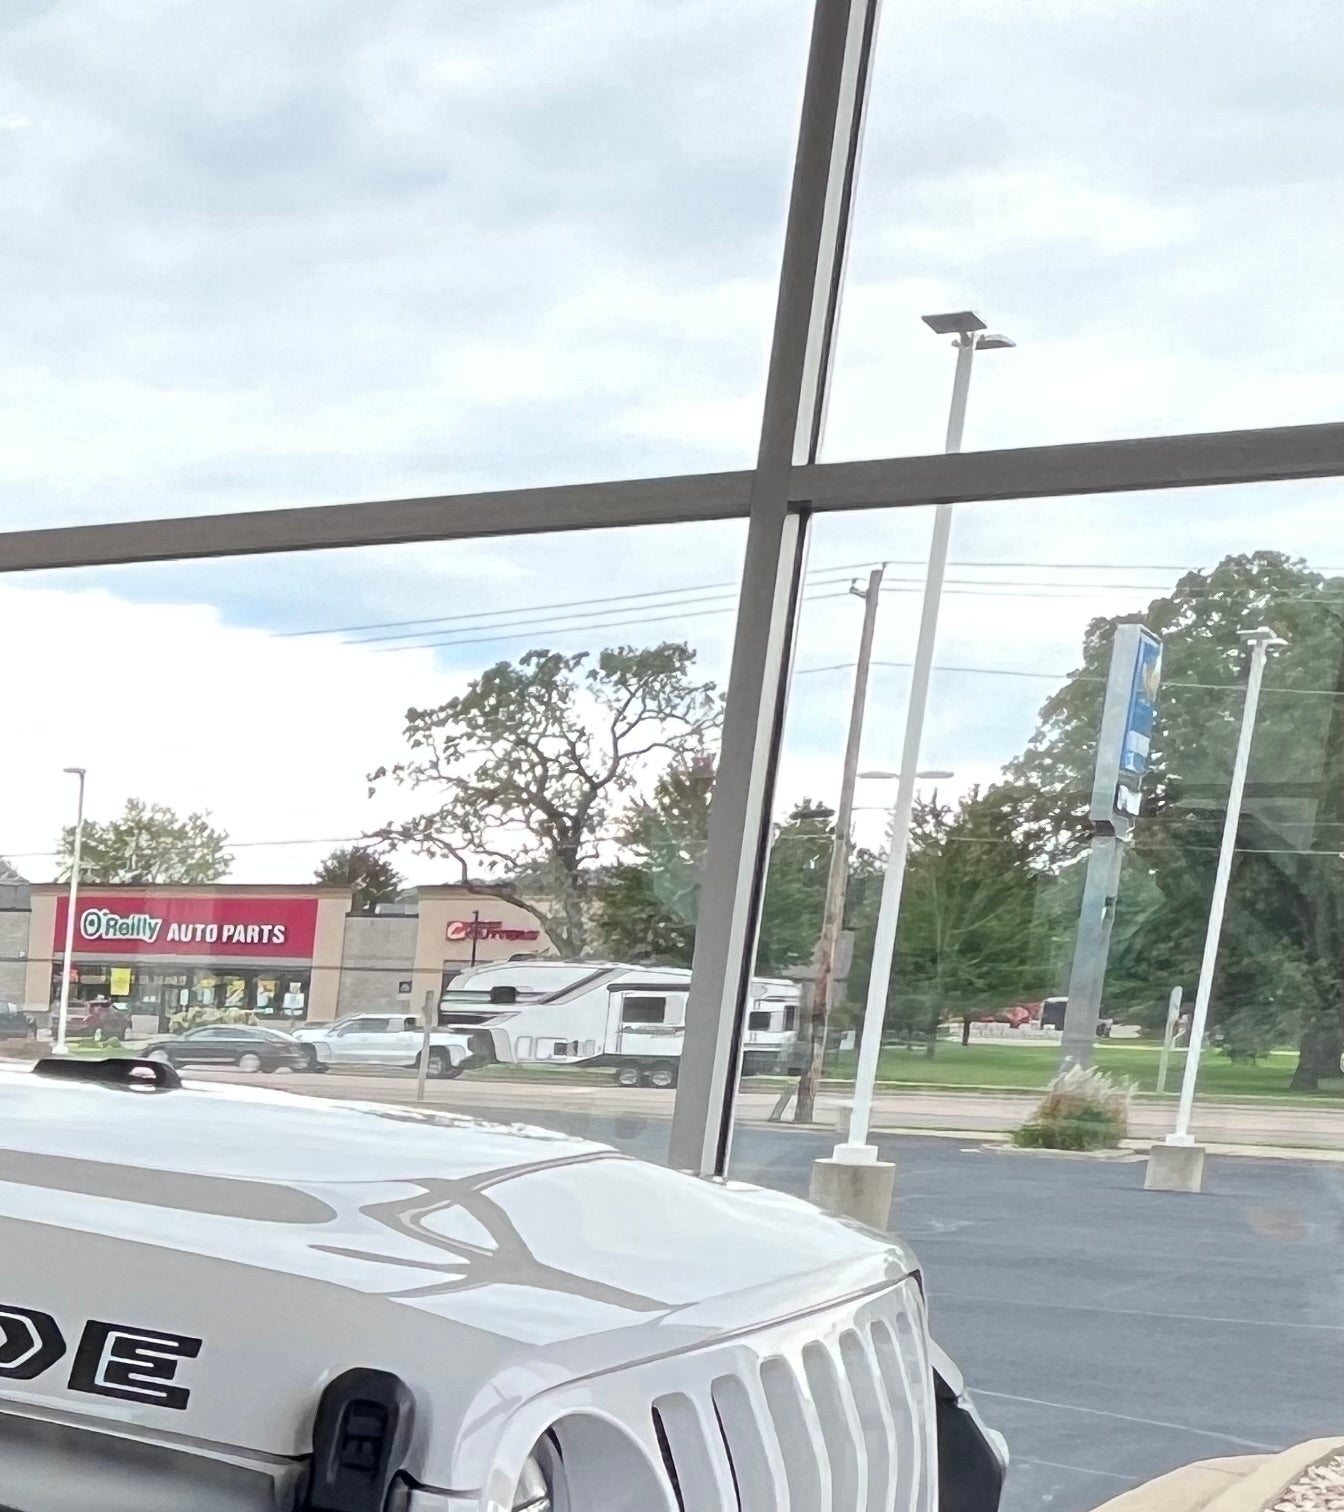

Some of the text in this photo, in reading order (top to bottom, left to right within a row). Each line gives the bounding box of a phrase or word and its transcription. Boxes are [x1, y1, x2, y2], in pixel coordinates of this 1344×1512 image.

[81, 909, 286, 944] O'Reilly AUTO PARTS
